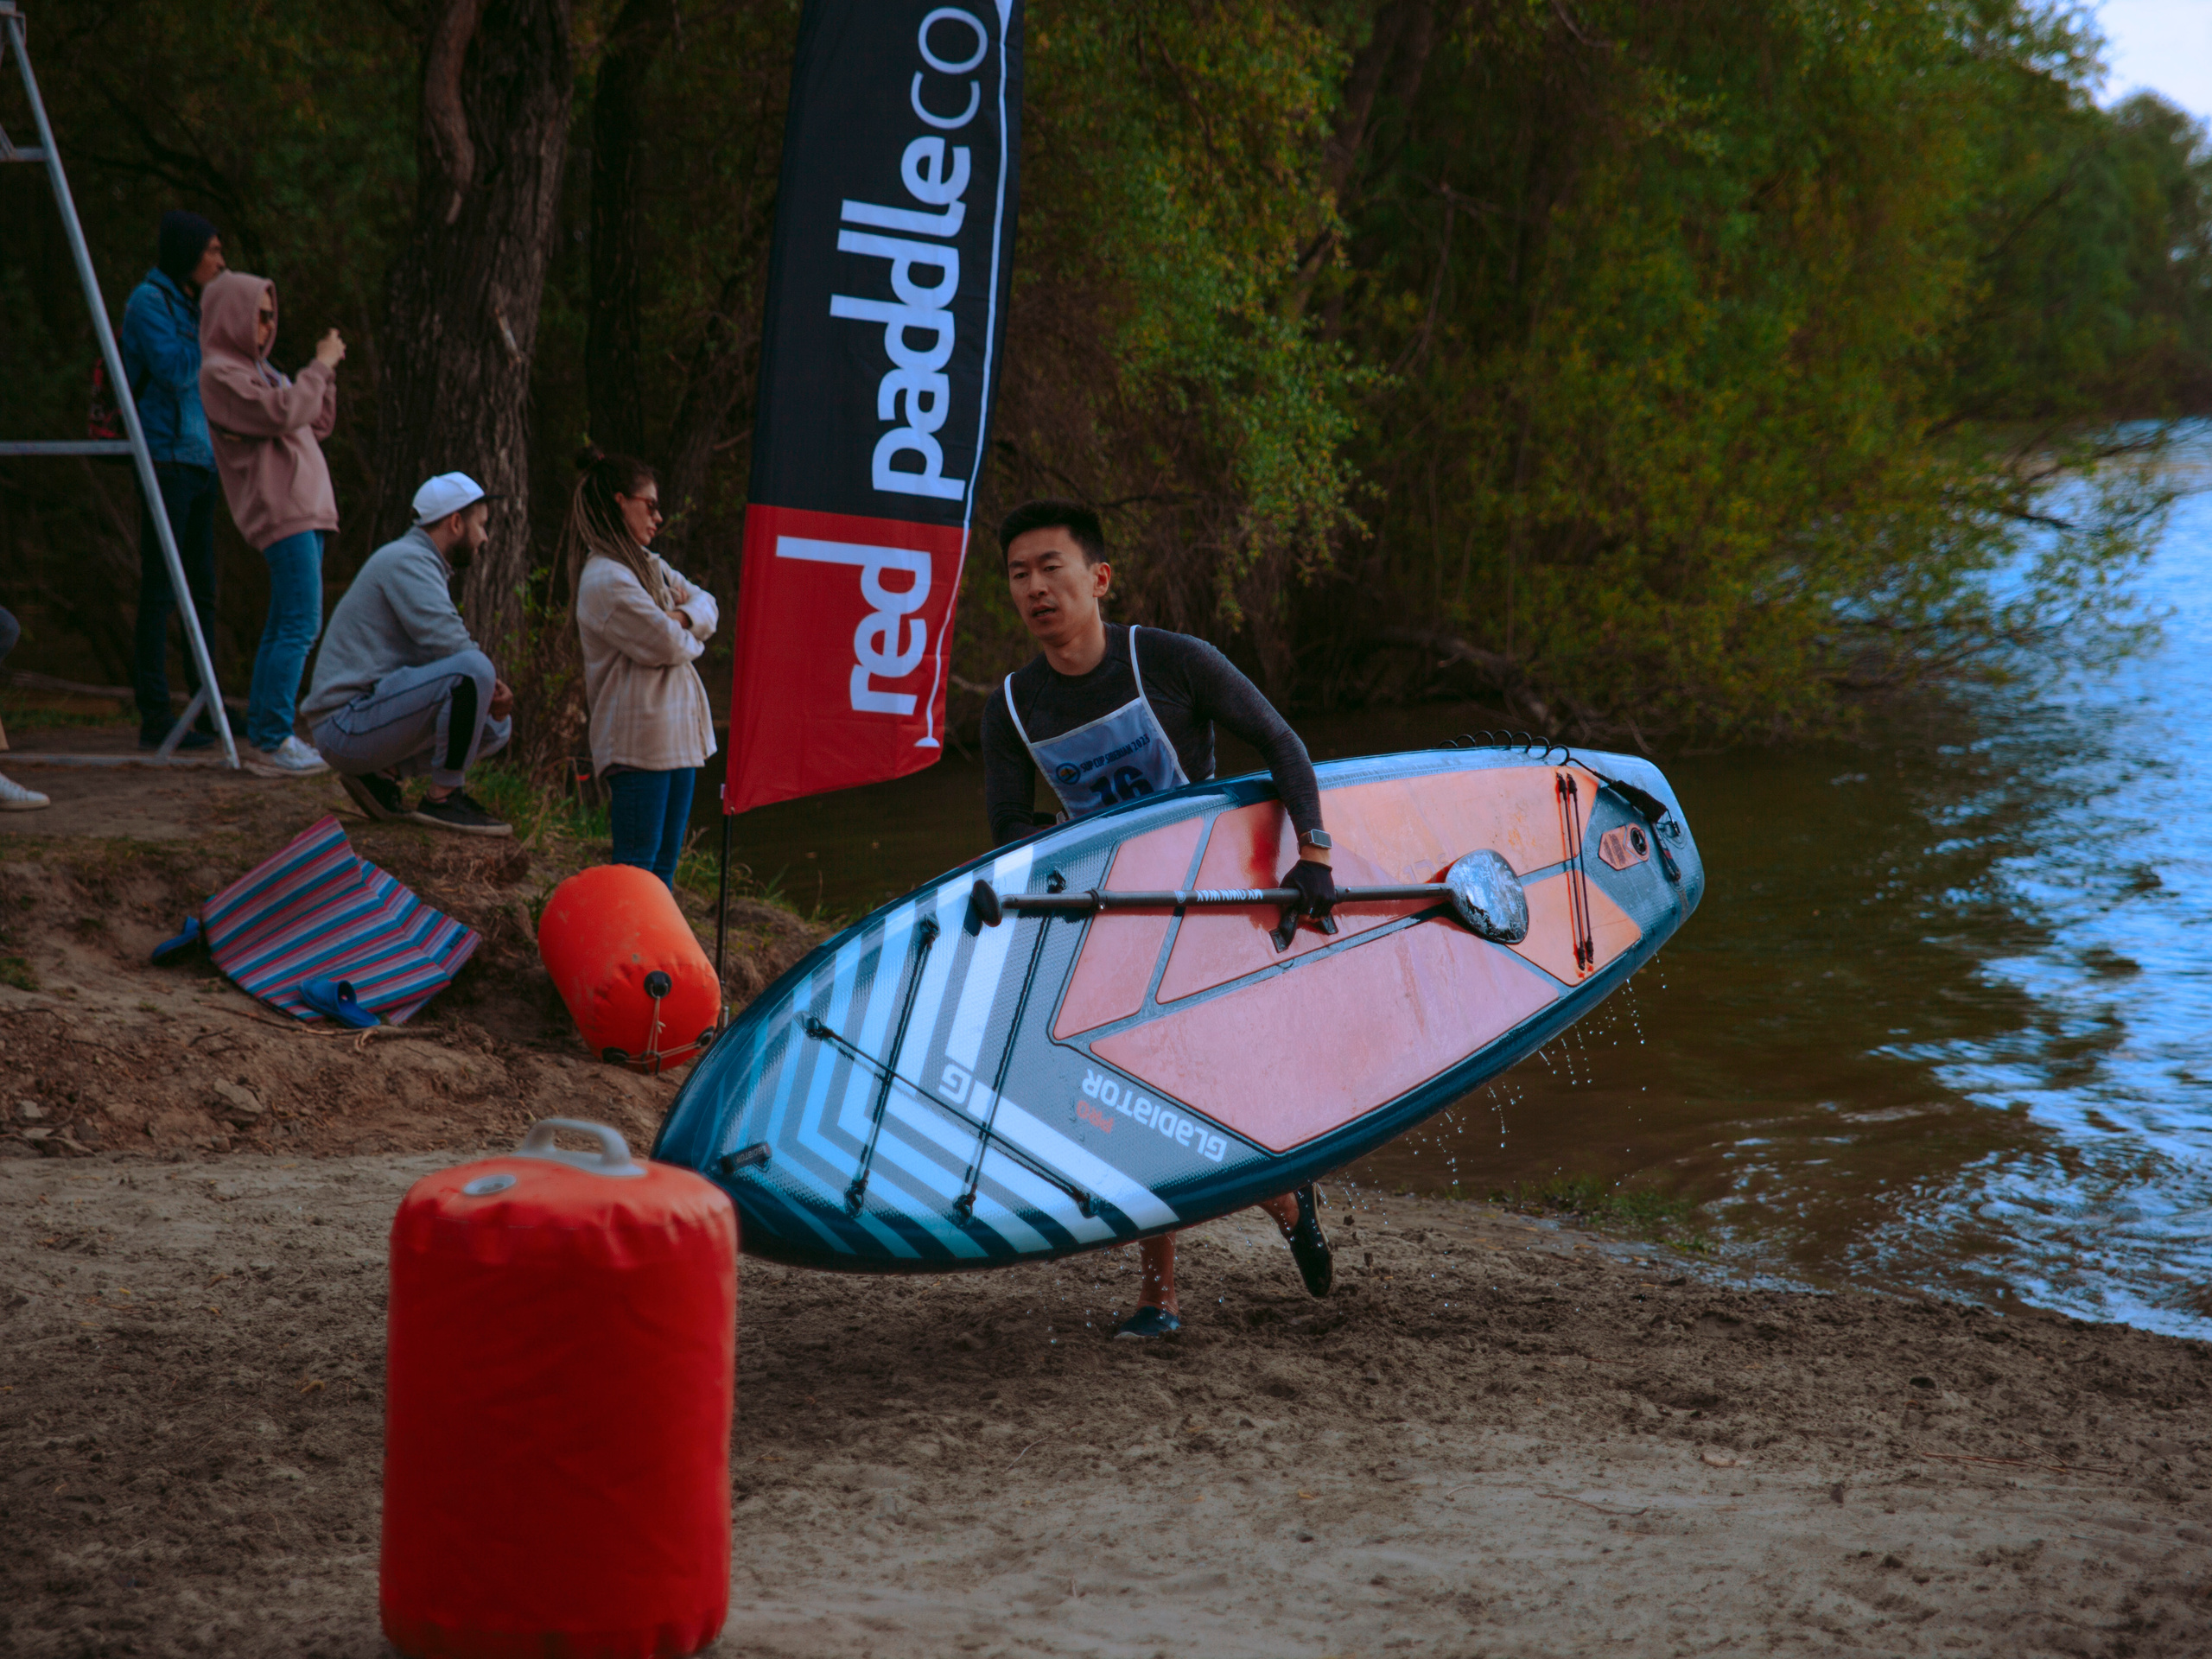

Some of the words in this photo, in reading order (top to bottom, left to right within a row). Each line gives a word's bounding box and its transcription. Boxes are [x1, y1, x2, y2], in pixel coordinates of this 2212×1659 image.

[775, 535, 932, 716] red
[1080, 760, 1094, 772] SUP
[1093, 756, 1105, 768] CUP
[1105, 744, 1134, 764] SIBERIAN
[1131, 733, 1150, 751] 2023
[1090, 766, 1154, 805] 16
[938, 1064, 972, 1104] G
[1076, 1100, 1115, 1135] PRO
